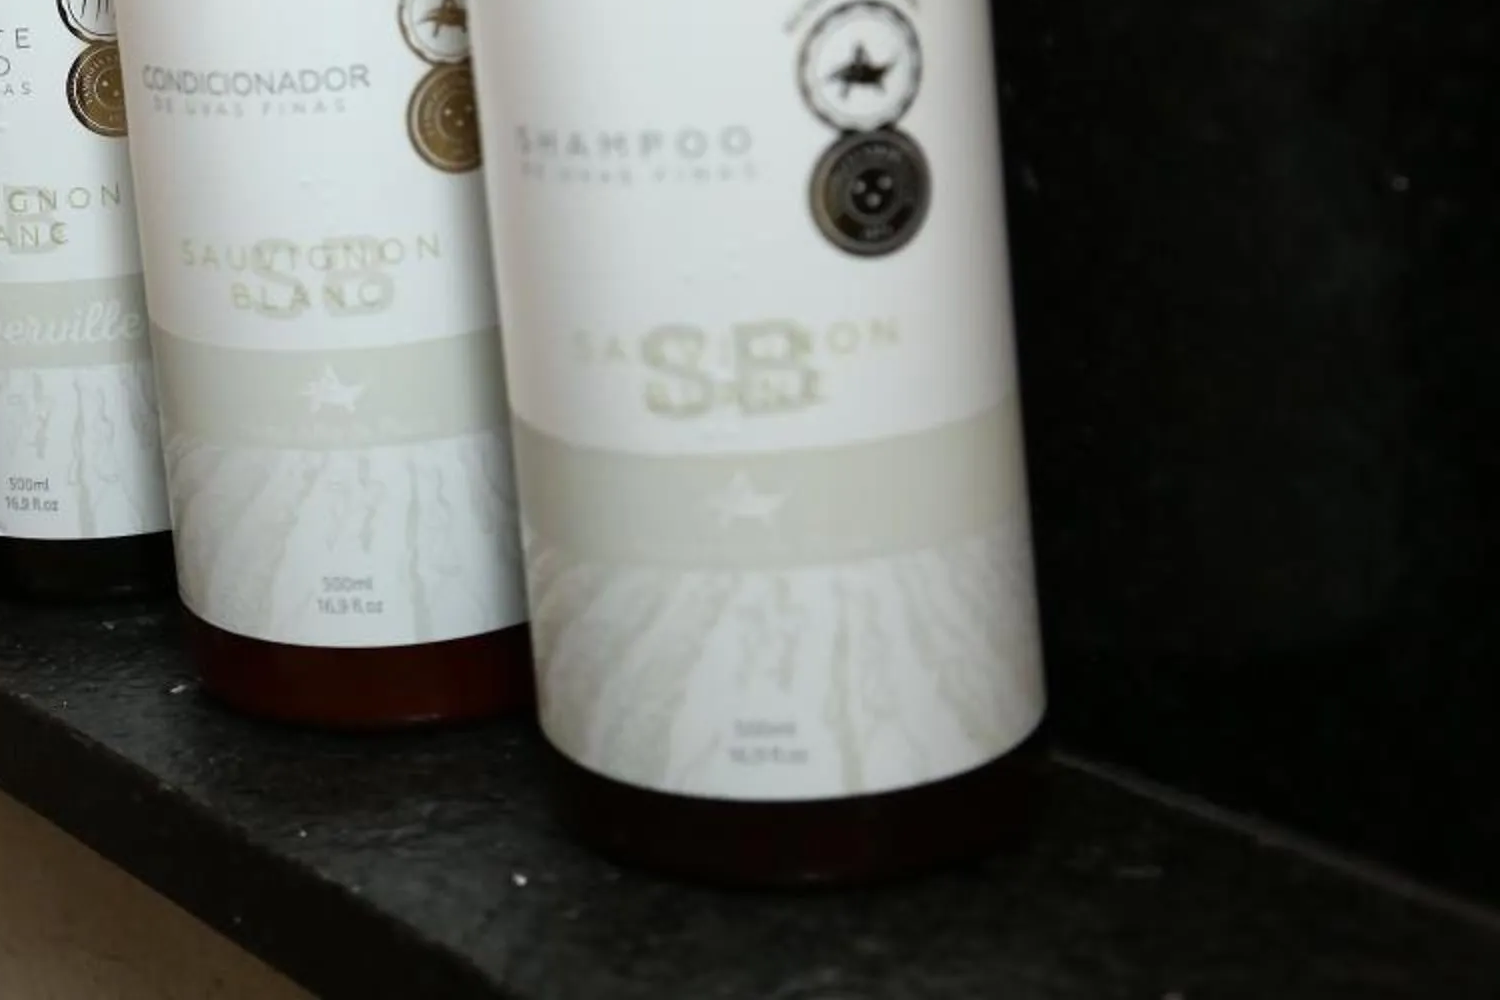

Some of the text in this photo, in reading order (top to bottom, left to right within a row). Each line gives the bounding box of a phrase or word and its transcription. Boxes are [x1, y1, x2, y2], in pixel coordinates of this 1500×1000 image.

[140, 63, 371, 97] CONDICIONADOR
[513, 122, 753, 161] SHAMPOO
[181, 232, 442, 272] SAUVIGNON
[640, 320, 822, 420] SB
[7, 476, 50, 492] 500ml
